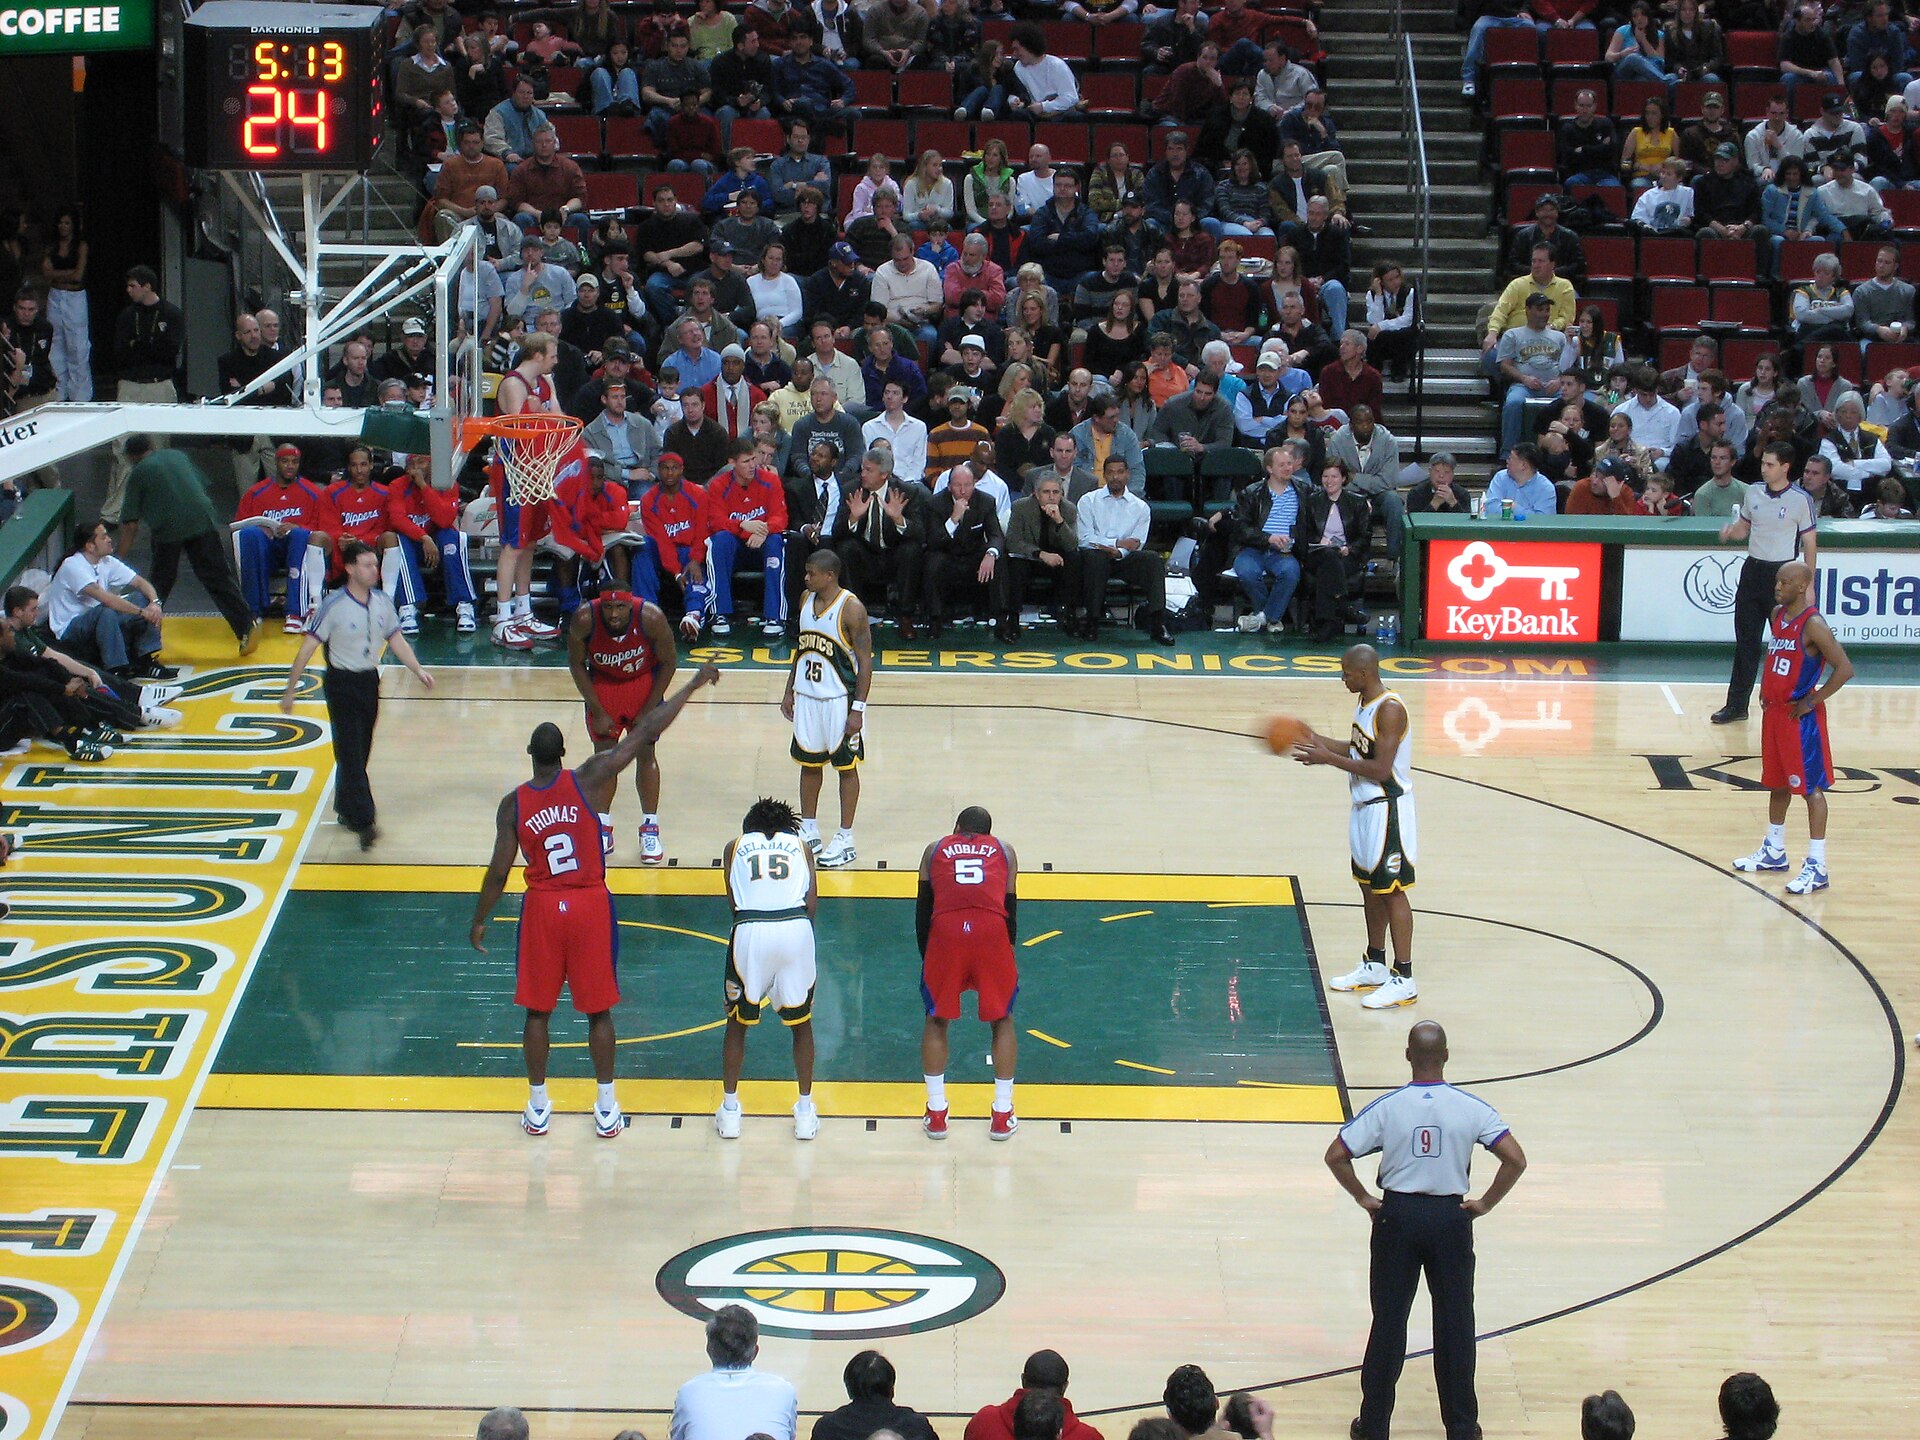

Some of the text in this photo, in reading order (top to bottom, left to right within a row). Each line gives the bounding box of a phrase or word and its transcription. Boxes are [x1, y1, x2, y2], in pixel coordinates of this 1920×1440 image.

[0, 6, 120, 36] COFFEE
[250, 26, 320, 34] DAKTRONICS
[255, 43, 342, 80] 5:13
[244, 87, 326, 154] 24
[1446, 605, 1580, 641] KeyBank
[1843, 624, 1856, 637] in
[1861, 624, 1898, 640] good
[593, 645, 645, 668] Clippers
[798, 635, 834, 657] SONICS
[622, 657, 645, 674] 42
[805, 659, 824, 683] 25
[1771, 655, 1791, 676] 19
[525, 804, 579, 835] THOMAS
[544, 832, 579, 877] 2
[942, 843, 997, 859] MOBLEY
[746, 853, 790, 882] 15
[954, 858, 985, 885] 5
[1420, 1129, 1431, 1154] 9
